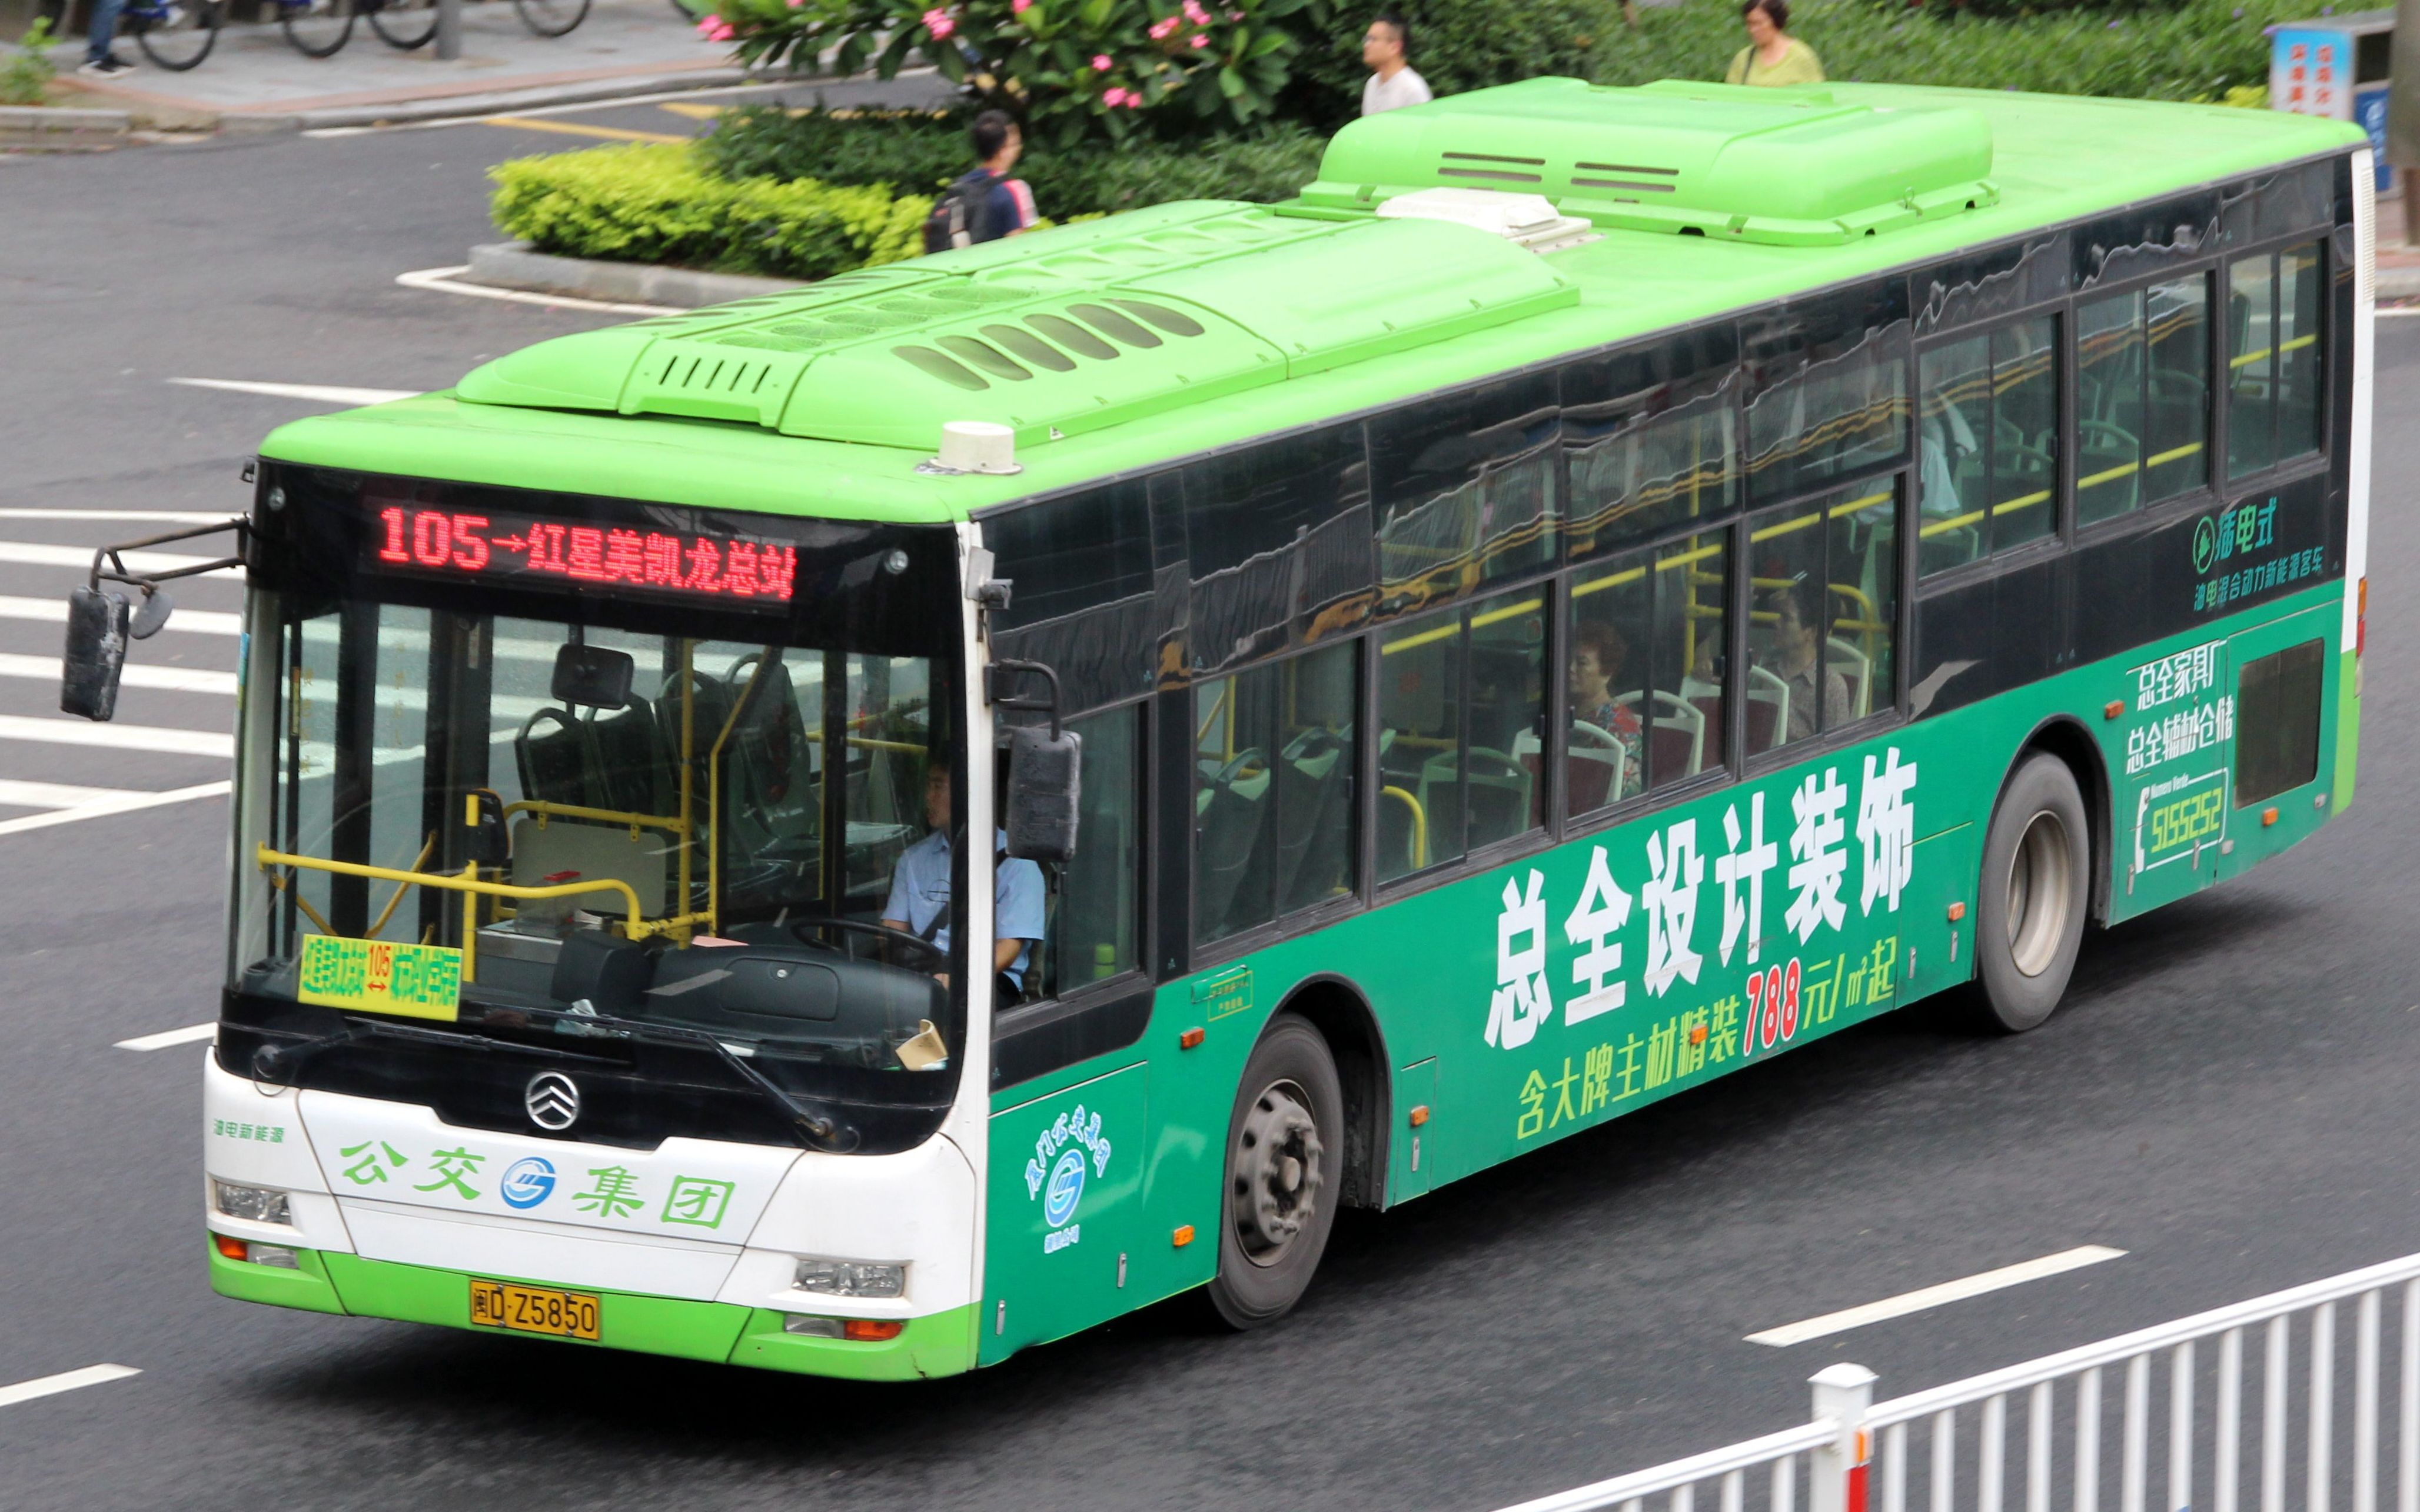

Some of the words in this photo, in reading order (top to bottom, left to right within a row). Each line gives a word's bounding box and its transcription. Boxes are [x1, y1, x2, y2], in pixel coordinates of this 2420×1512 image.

[380, 507, 490, 570] 105
[2215, 496, 2277, 561] 插电式
[2194, 546, 2323, 611] 油电混合动力新能源客车
[2126, 695, 2233, 775] 总全辅材仓储
[2152, 787, 2223, 853] 5155252
[1484, 747, 1917, 1051] 总全设计装饰
[369, 944, 391, 977] 105
[213, 1118, 285, 1143] 油电新能源
